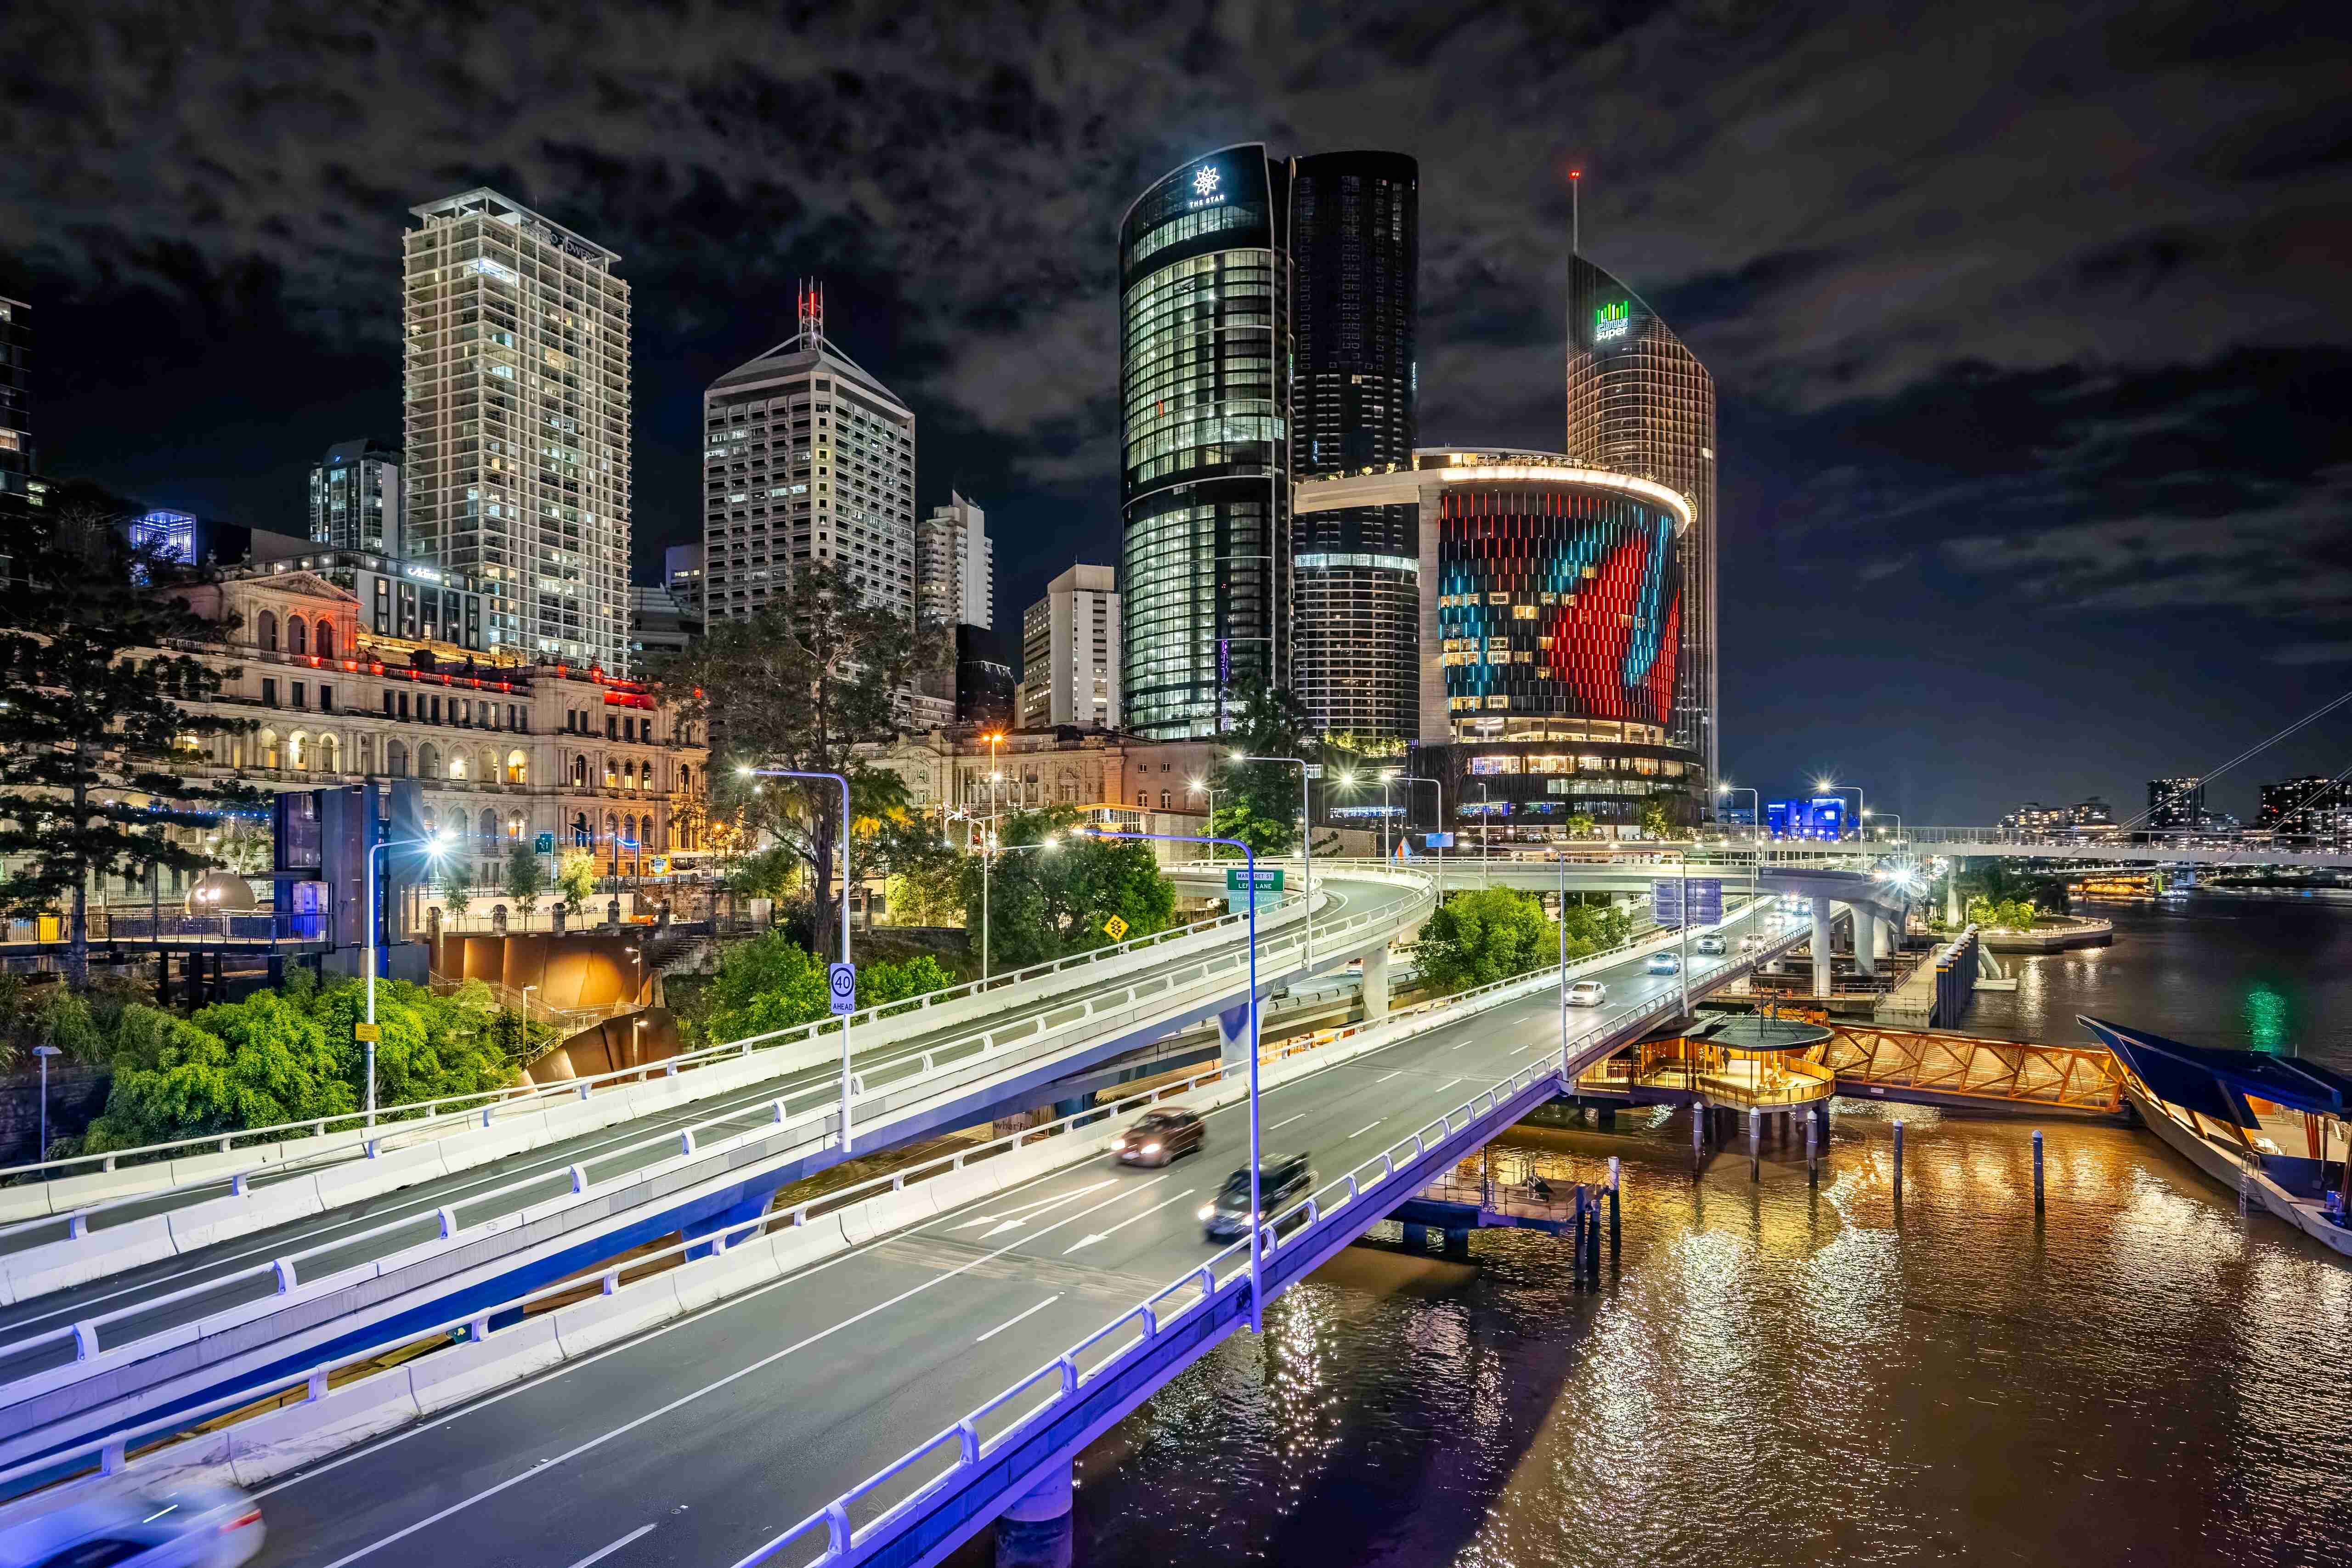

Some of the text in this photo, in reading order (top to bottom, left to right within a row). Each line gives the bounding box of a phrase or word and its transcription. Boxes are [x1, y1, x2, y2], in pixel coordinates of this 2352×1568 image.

[1189, 194, 1224, 208] THE STAR
[1597, 317, 1628, 333] cbus
[1596, 326, 1628, 341] super
[835, 976, 850, 989] 40
